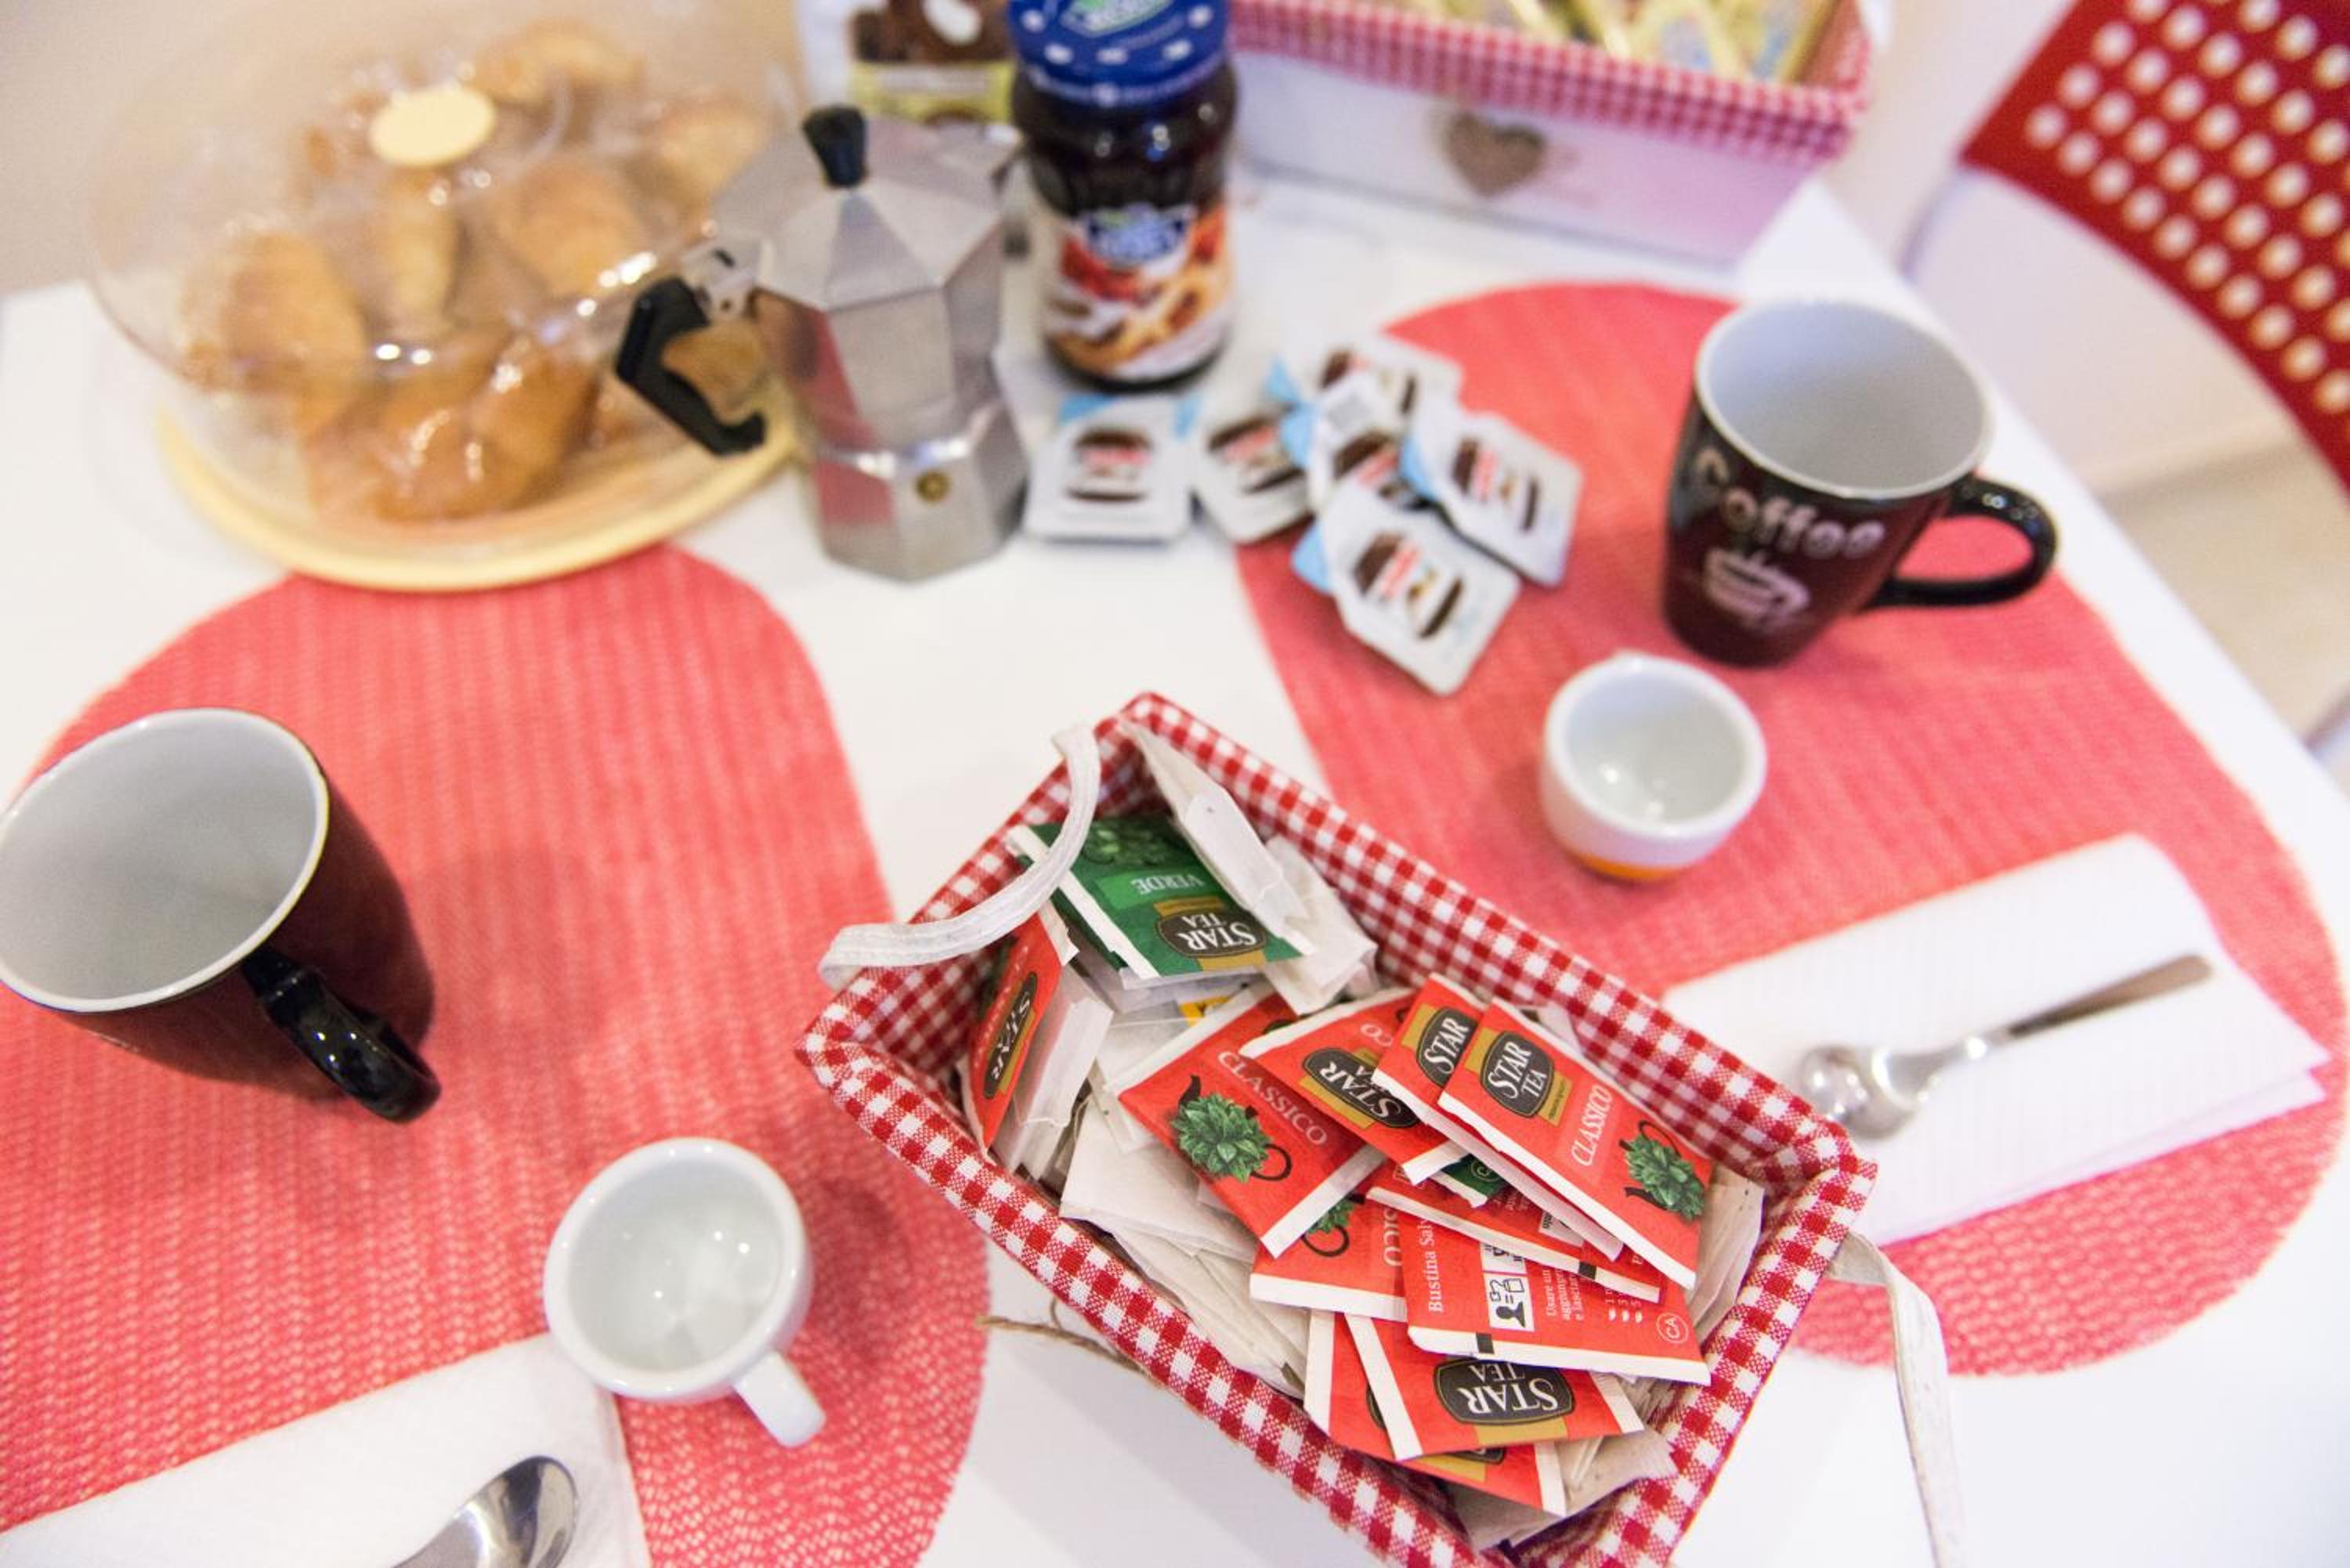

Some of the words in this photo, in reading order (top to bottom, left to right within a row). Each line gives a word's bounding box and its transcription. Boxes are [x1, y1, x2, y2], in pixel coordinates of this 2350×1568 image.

[1696, 447, 1885, 559] Coffee
[1130, 873, 1205, 895] VERDE
[1177, 921, 1257, 951] STAR
[1180, 912, 1227, 928] TEA
[1424, 1017, 1470, 1075] STAR
[1319, 1061, 1402, 1118] STAR
[1488, 1041, 1532, 1100] STAR
[1520, 1068, 1548, 1097] TEA
[1218, 1051, 1328, 1146] CLASSICO
[1571, 1084, 1614, 1166] CLASSICO
[1424, 1251, 1444, 1313] Bustina
[1665, 1317, 1680, 1339] CA
[1457, 1377, 1559, 1414] STAR
[1468, 1362, 1526, 1383] TEA
